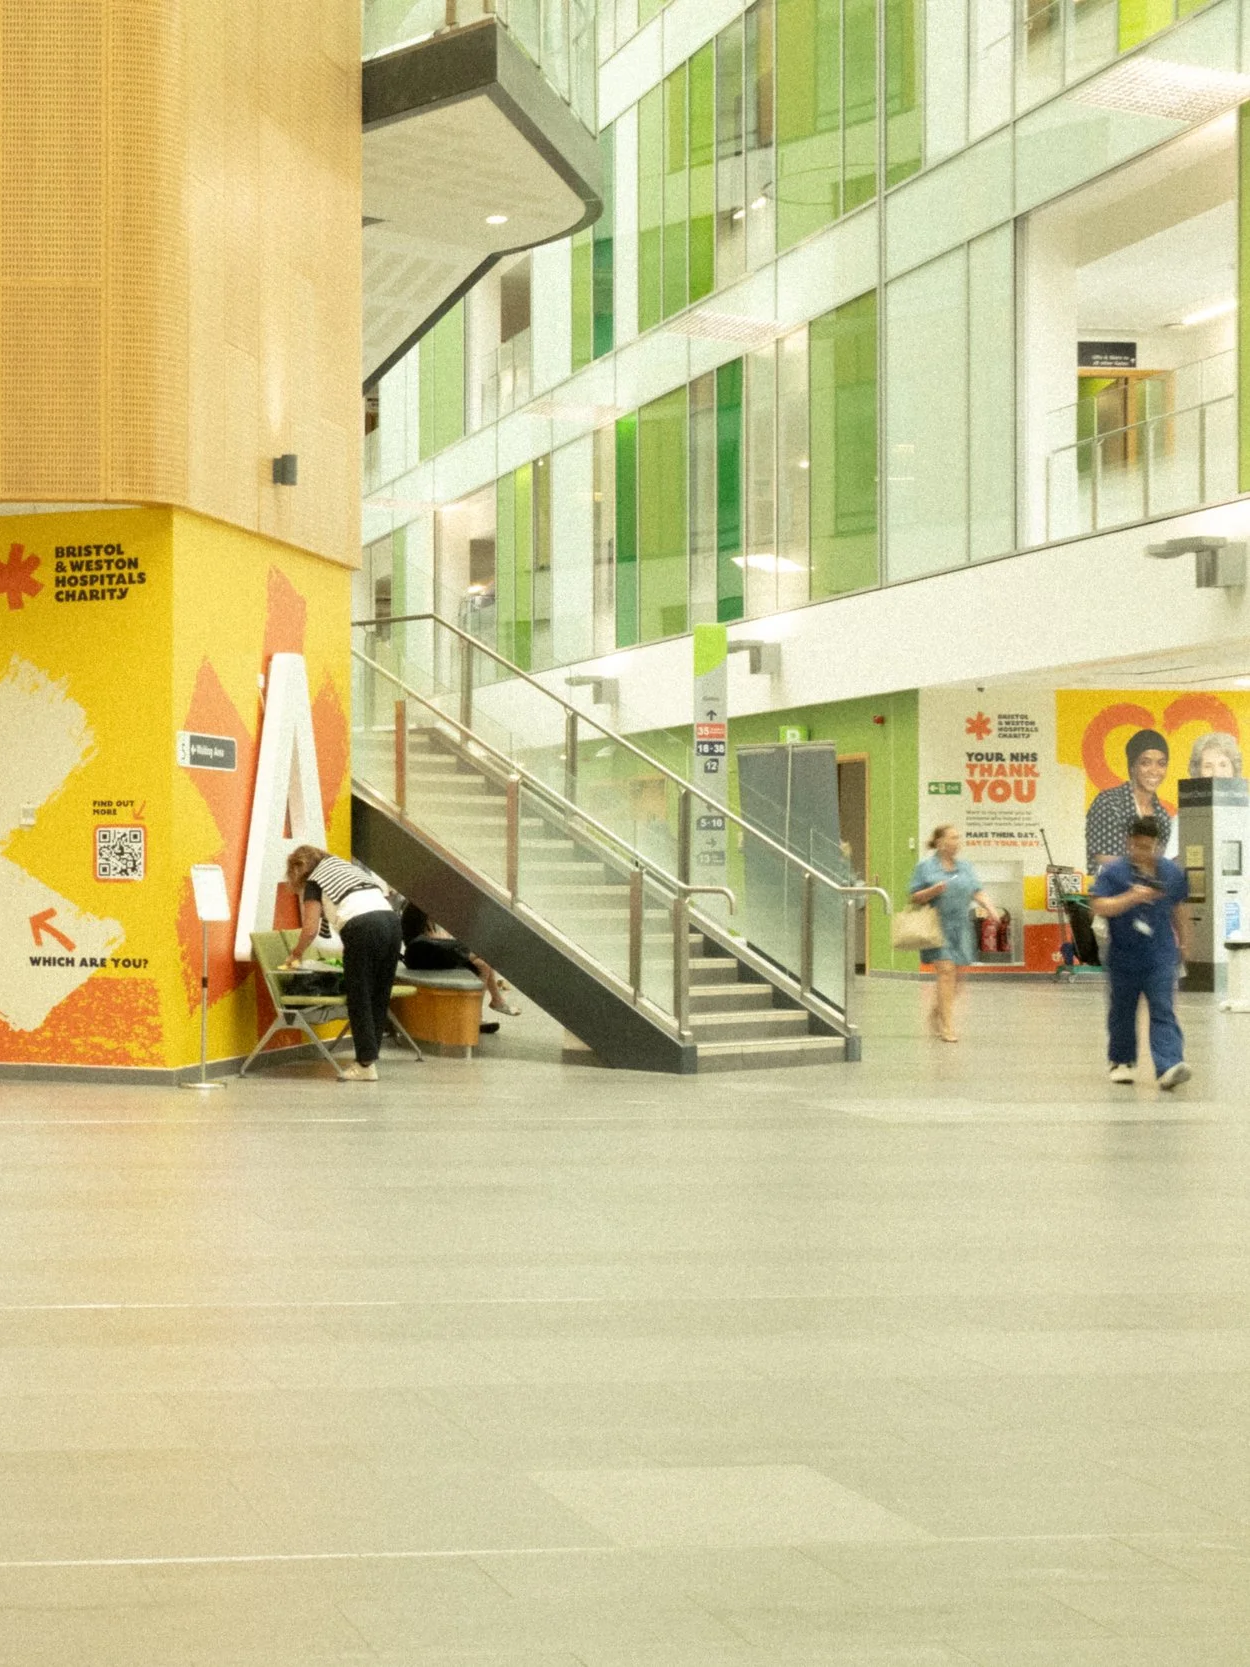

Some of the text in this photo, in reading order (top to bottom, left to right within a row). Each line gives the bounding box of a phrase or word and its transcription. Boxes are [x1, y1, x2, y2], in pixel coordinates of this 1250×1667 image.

[55, 544, 124, 558] BRISTOL
[55, 558, 138, 573] & WESTON
[55, 572, 146, 588] HOSPITALS
[55, 588, 129, 602] CHARITY
[966, 752, 1038, 762] YOUR NHS
[706, 761, 717, 770] 12
[966, 763, 1040, 777] THANK
[965, 779, 1037, 803] YOU
[29, 956, 148, 969] WHICH ARE YOU?
